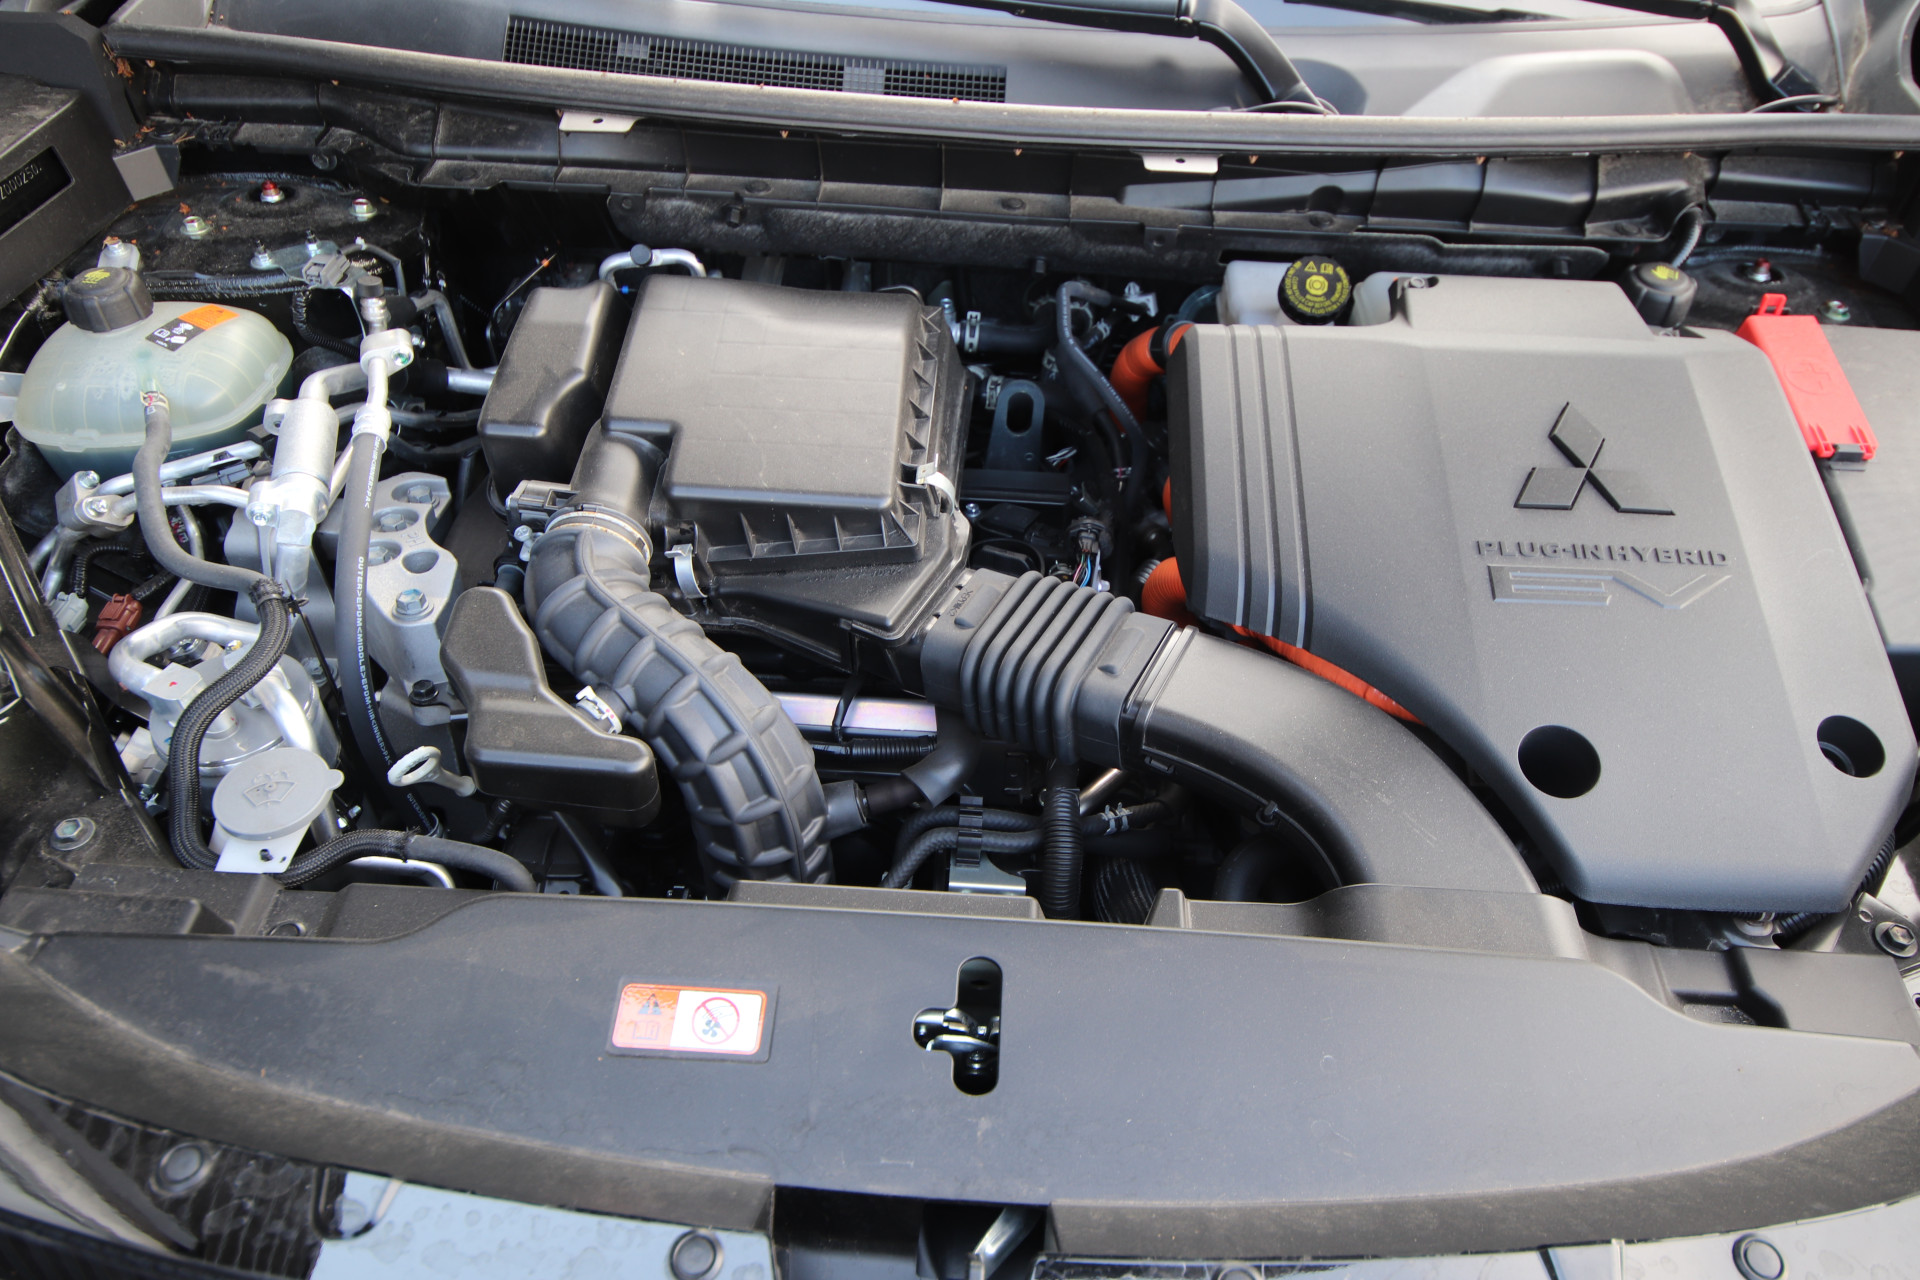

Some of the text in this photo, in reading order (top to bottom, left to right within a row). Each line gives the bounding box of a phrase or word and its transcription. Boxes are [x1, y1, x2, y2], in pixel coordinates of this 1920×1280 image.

[1475, 540, 1730, 567] PLUG-IN HYBRID
[1487, 563, 1733, 610] EV
